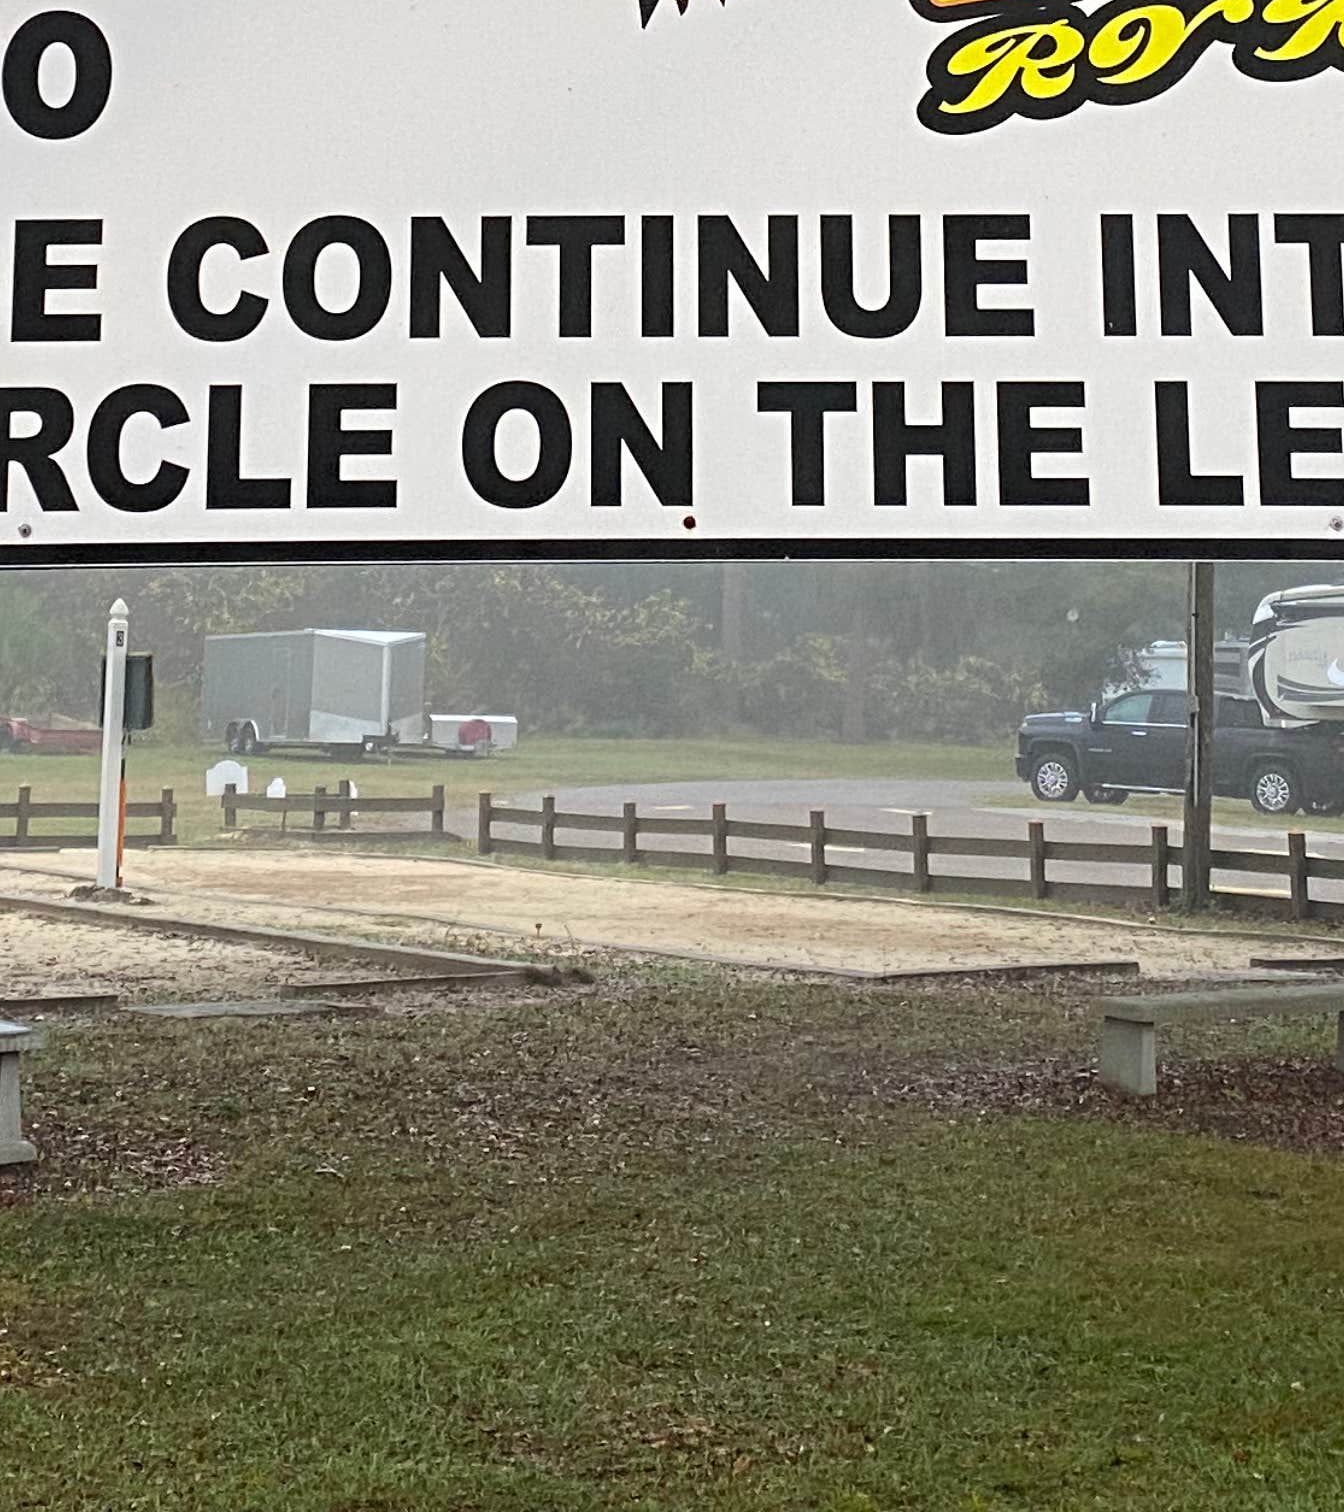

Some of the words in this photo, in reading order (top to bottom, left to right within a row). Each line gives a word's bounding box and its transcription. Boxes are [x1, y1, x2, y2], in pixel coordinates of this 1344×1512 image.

[167, 213, 1035, 343] CONTINUE
[461, 380, 693, 509] ON
[756, 380, 1091, 507] THE
